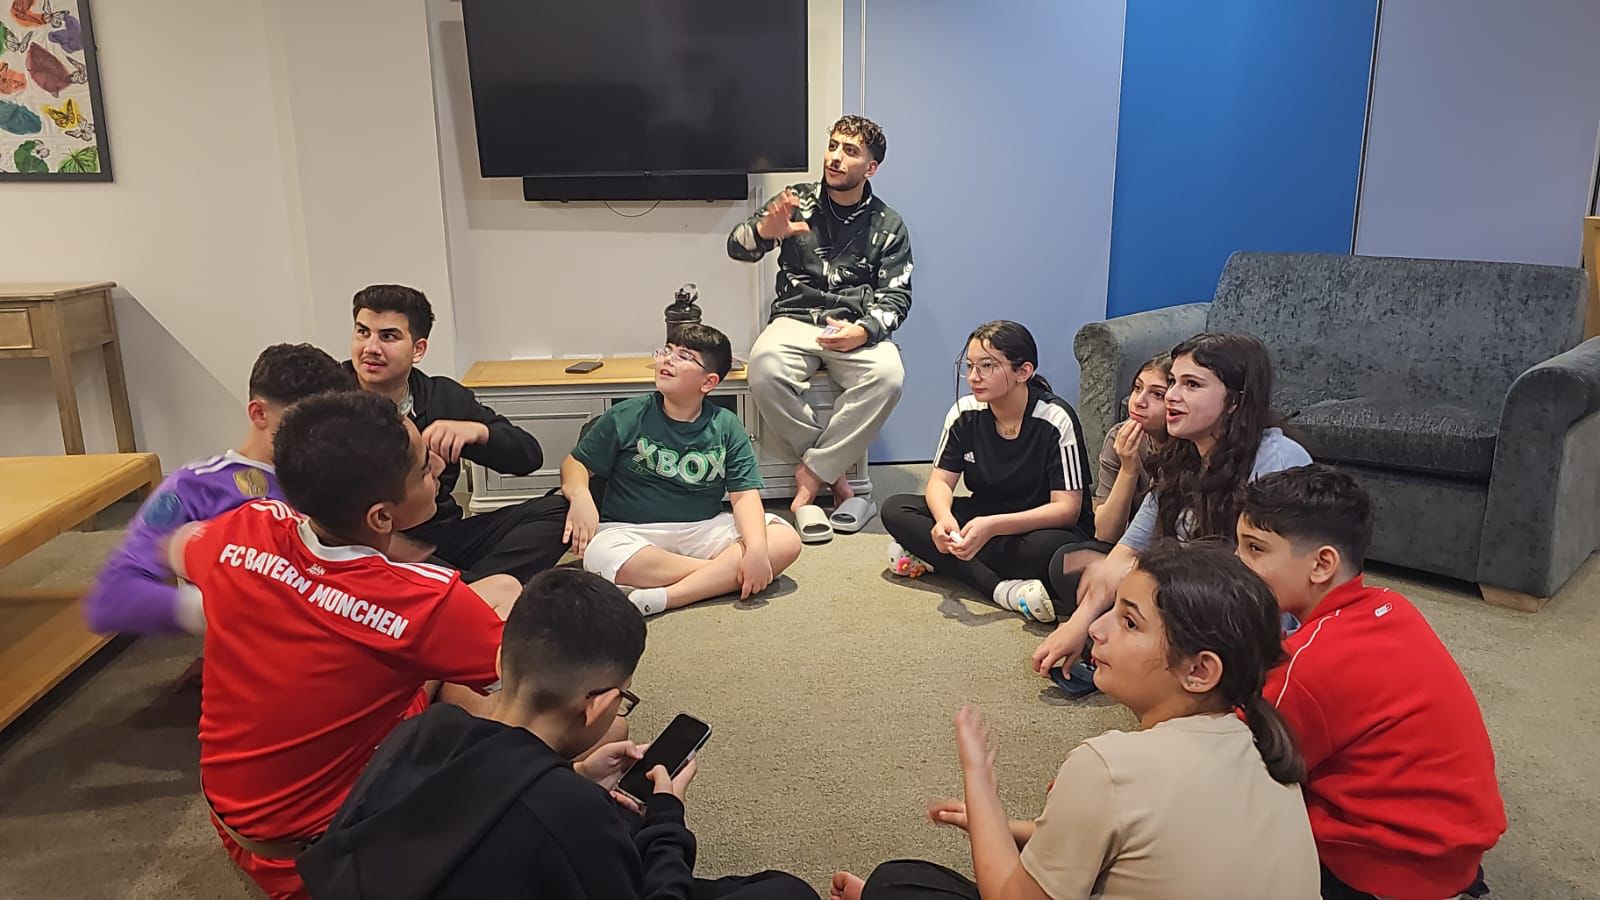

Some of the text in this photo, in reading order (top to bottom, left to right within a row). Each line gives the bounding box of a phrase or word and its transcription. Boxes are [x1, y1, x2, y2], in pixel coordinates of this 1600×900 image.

[632, 437, 726, 484] XBOX
[219, 543, 409, 639] FC BAYERN MÜNCHEN
